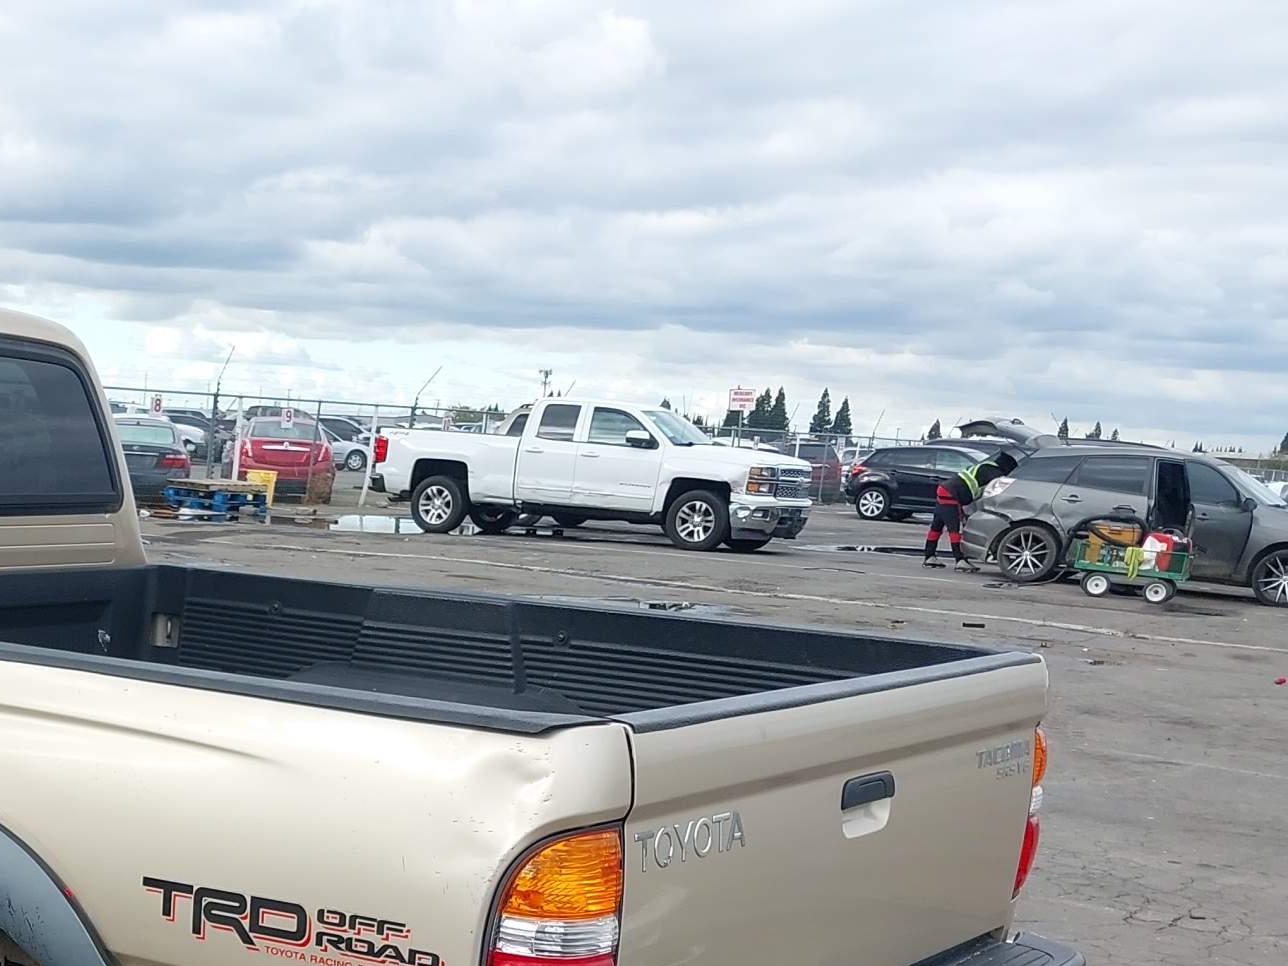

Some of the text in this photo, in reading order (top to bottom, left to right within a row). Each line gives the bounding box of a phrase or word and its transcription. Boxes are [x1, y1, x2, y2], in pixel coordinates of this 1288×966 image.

[153, 398, 161, 412] 8
[285, 410, 293, 422] 9
[976, 740, 1030, 769] TACOMA
[633, 811, 746, 873] TOYOTA
[142, 876, 312, 951] TRD
[316, 908, 411, 942] OFF
[264, 945, 307, 962] TOYOTA
